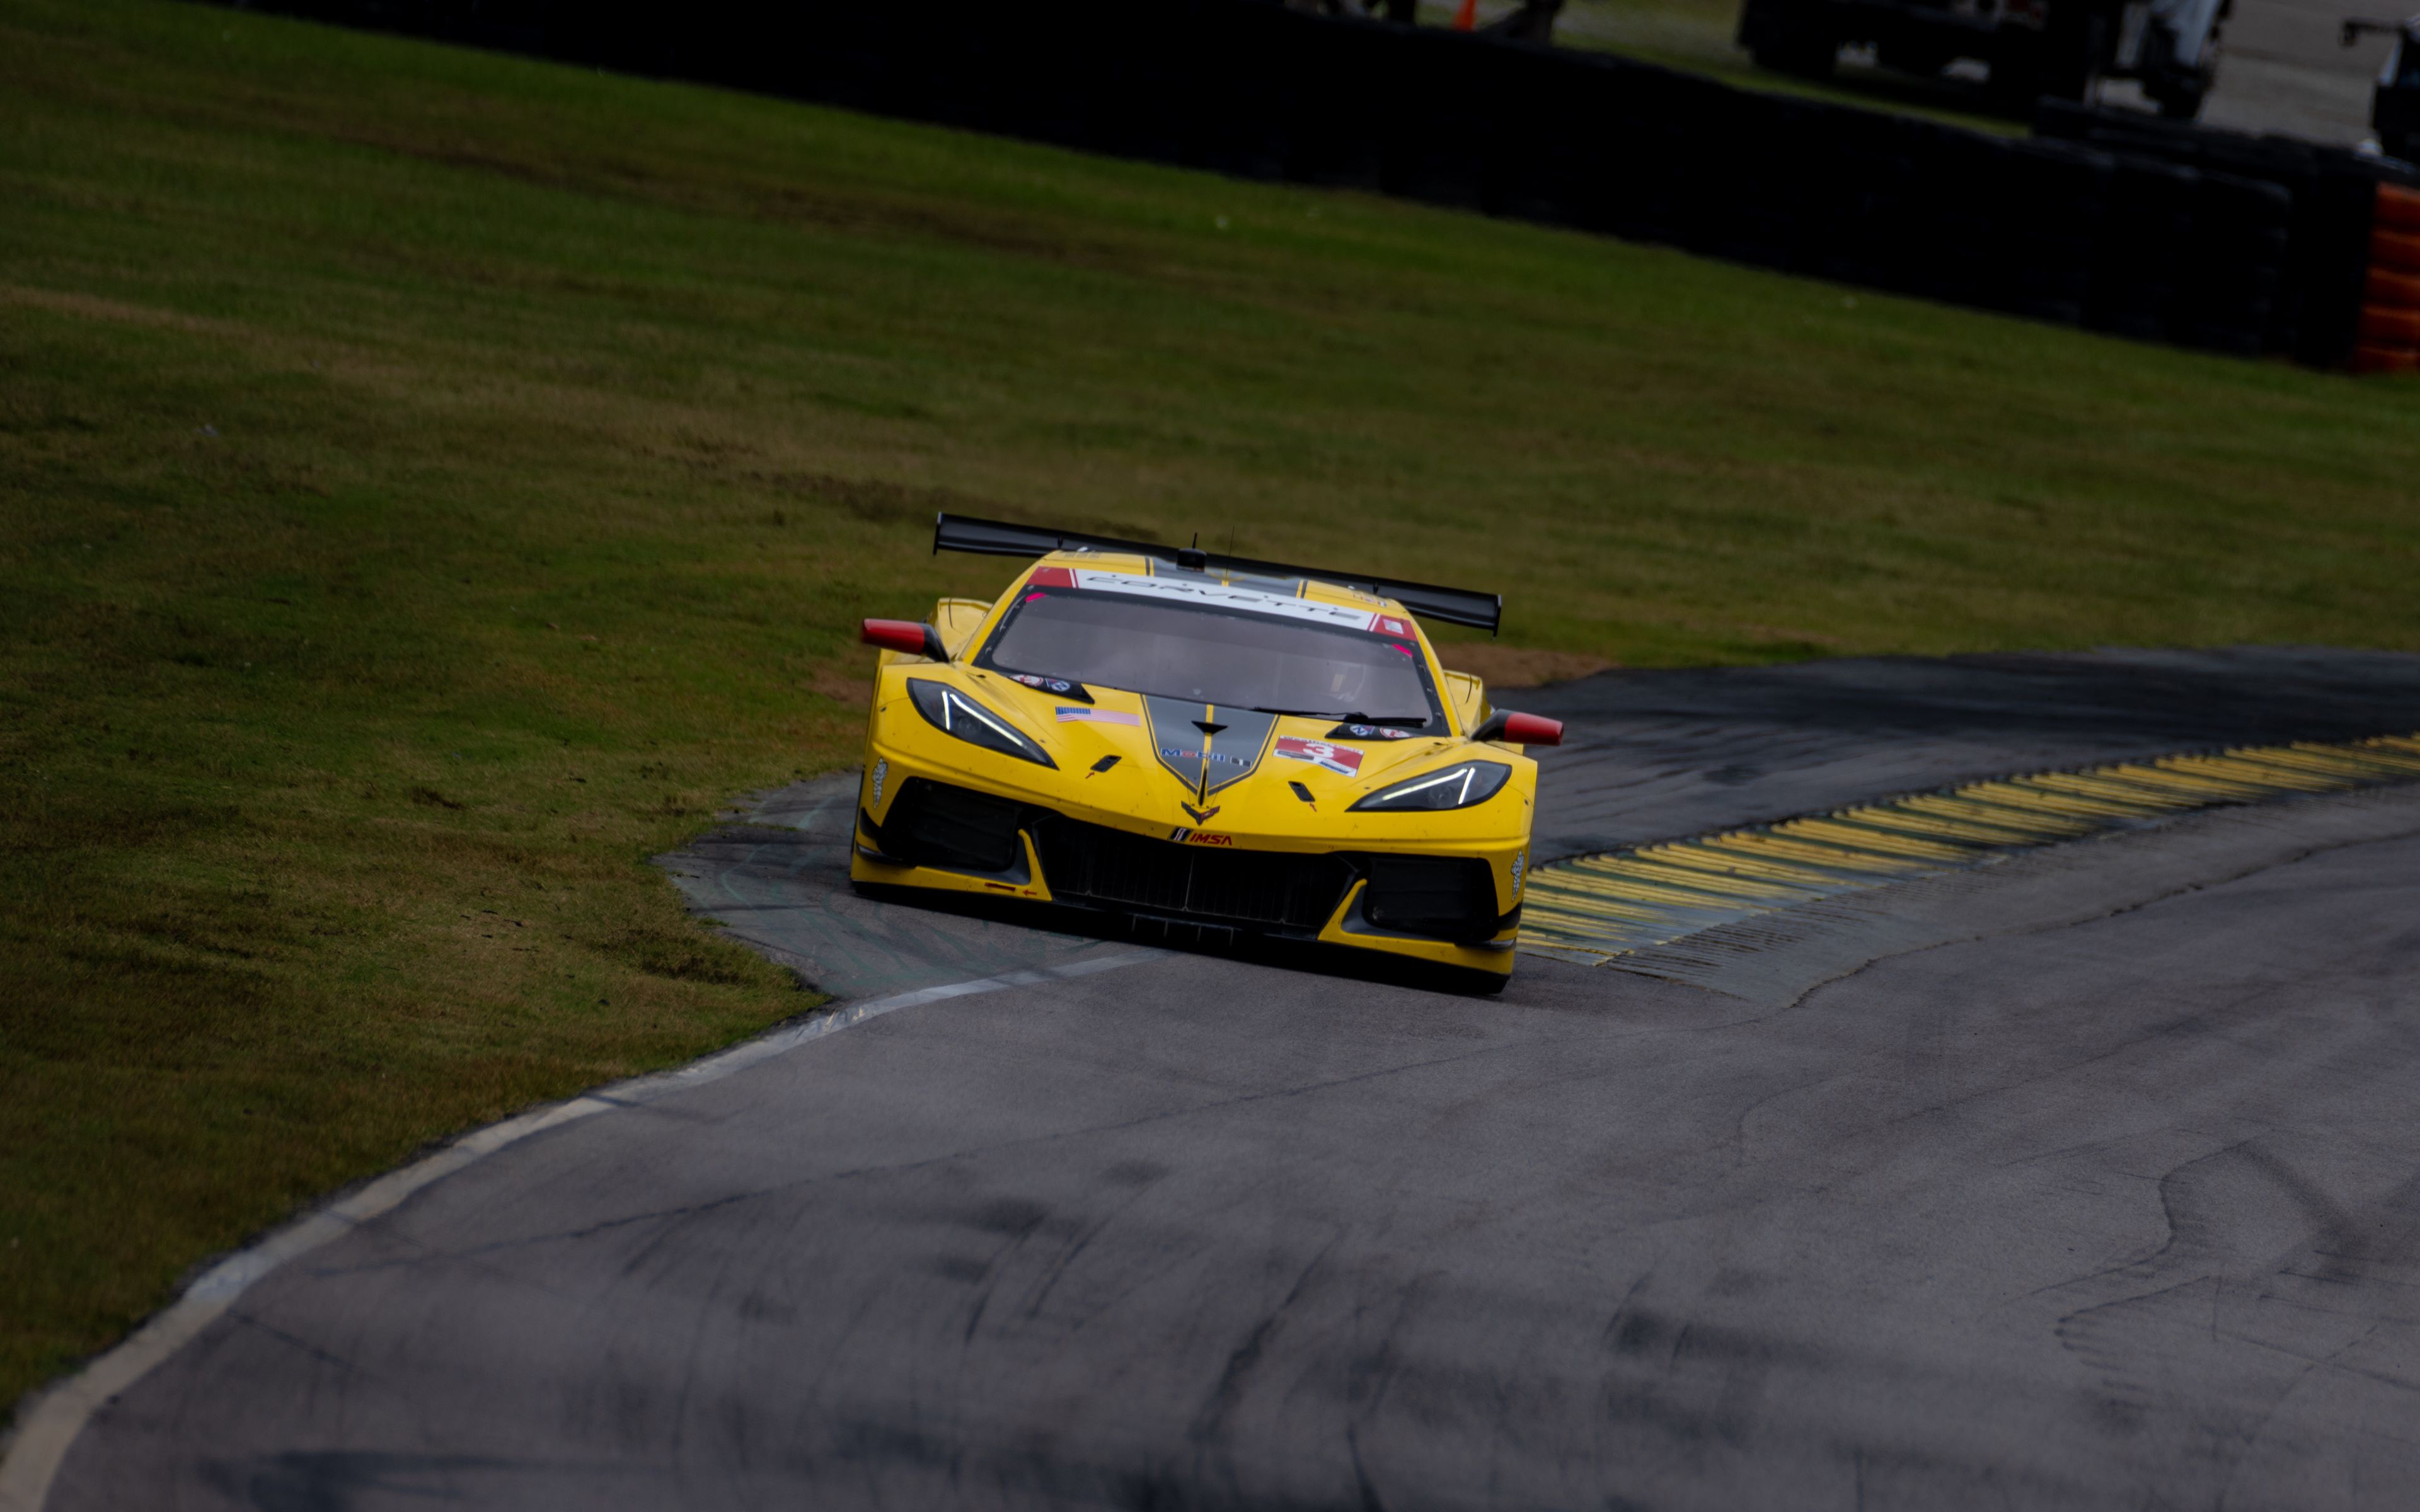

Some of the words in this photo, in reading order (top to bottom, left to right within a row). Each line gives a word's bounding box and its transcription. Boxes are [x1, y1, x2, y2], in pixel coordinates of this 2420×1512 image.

[1086, 576, 1361, 620] CORVETTE
[1160, 747, 1226, 762] Mobil
[1303, 743, 1335, 758] 3
[1190, 832, 1233, 845] IMSA
